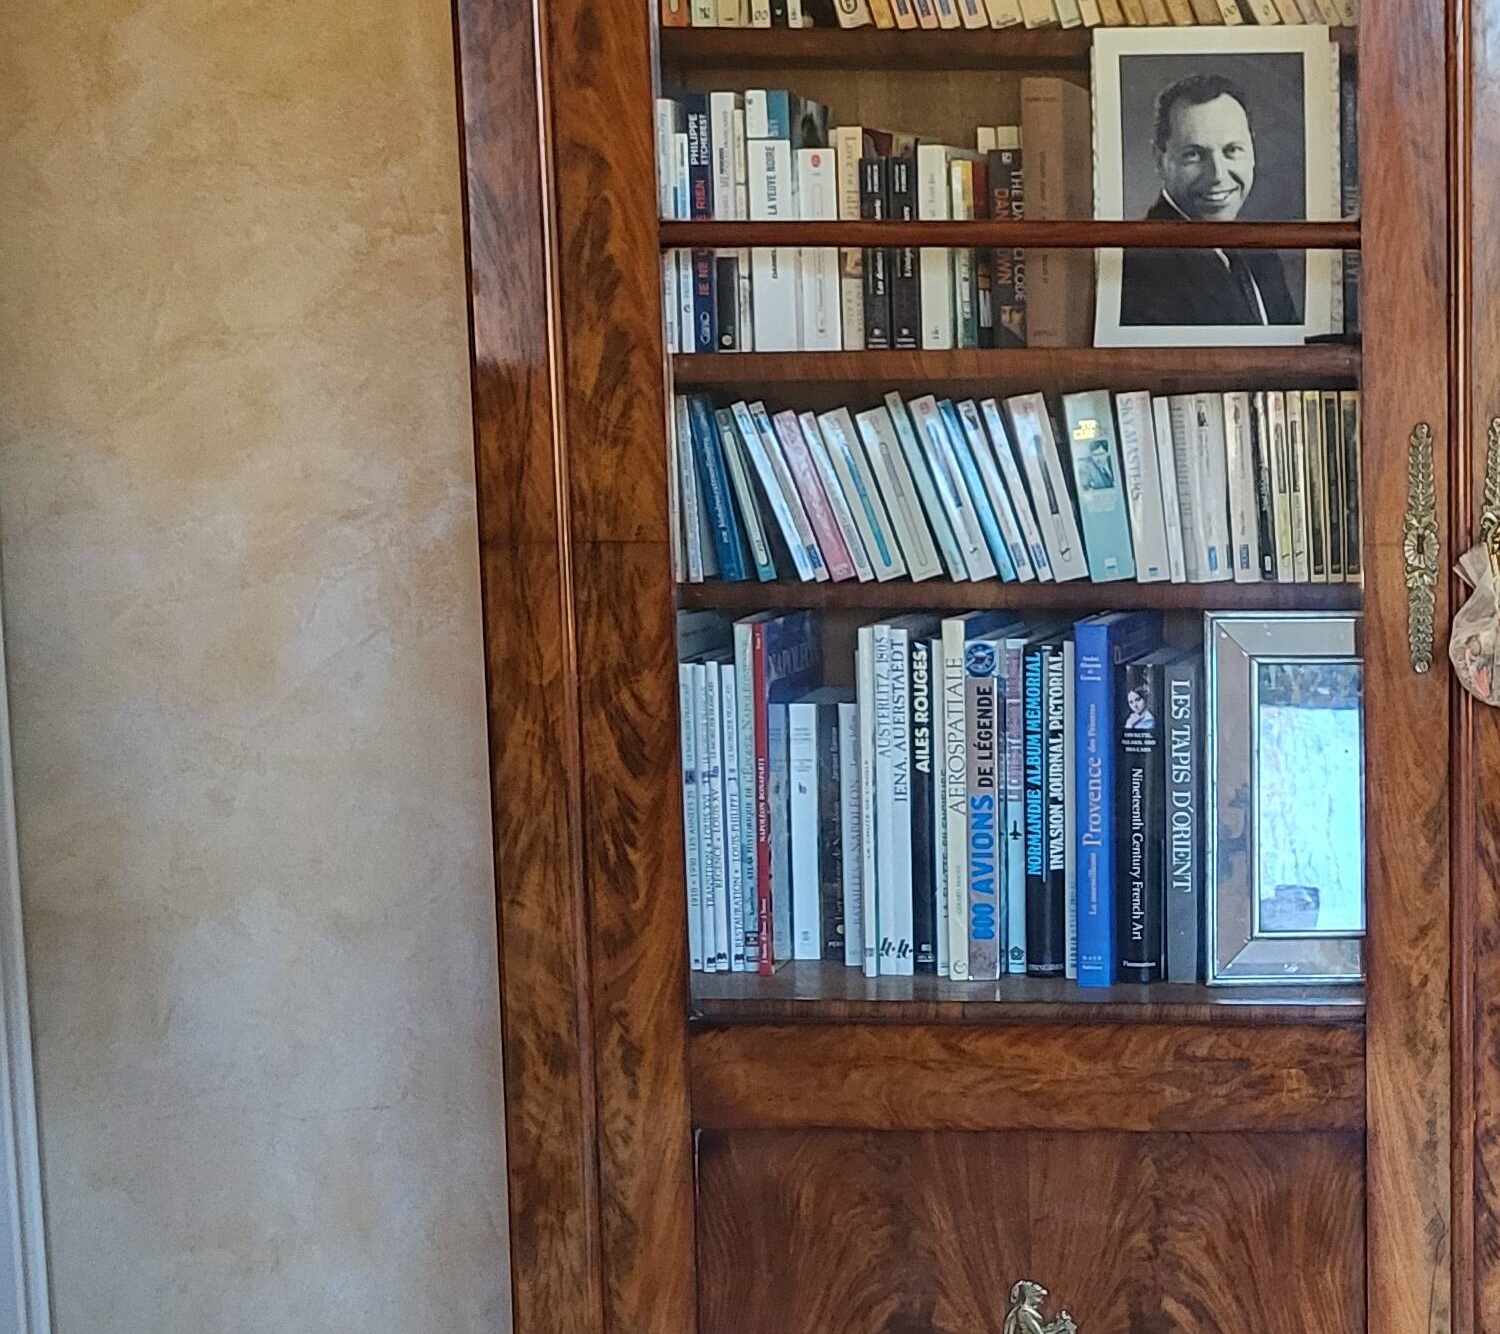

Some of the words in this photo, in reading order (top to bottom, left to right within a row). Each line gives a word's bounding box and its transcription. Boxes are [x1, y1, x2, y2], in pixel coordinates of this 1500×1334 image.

[688, 113, 700, 165] PHILIPPE
[765, 145, 776, 172] NOIRE
[695, 179, 707, 209] RIEN
[766, 174, 777, 203] VEUVE
[767, 204, 777, 216] LA
[1011, 169, 1025, 199] THE
[890, 638, 908, 752] AUERSTAEDT
[912, 650, 930, 723] ROUGES
[1047, 651, 1064, 730] PICTORIAL
[1171, 679, 1191, 719] LES
[973, 686, 993, 760] LÉGENDE
[914, 727, 931, 773] AILES
[1026, 738, 1042, 786] ALBUM
[1048, 733, 1064, 802] JOURNAL
[1171, 724, 1191, 784] TAPIS
[977, 766, 993, 788] DE
[1082, 757, 1103, 847] Provence
[1131, 767, 1145, 831] Nineteenth
[757, 801, 767, 843] NAPOLÉON
[971, 794, 994, 895] AVIONS
[1026, 789, 1042, 875] NORMANDIE
[1048, 803, 1065, 870] INVASION
[1171, 790, 1194, 893] D'ORIENT
[1129, 832, 1145, 879] Century
[731, 876, 743, 948] RESTAURATION
[1131, 880, 1145, 918] French
[1131, 920, 1145, 940] Art
